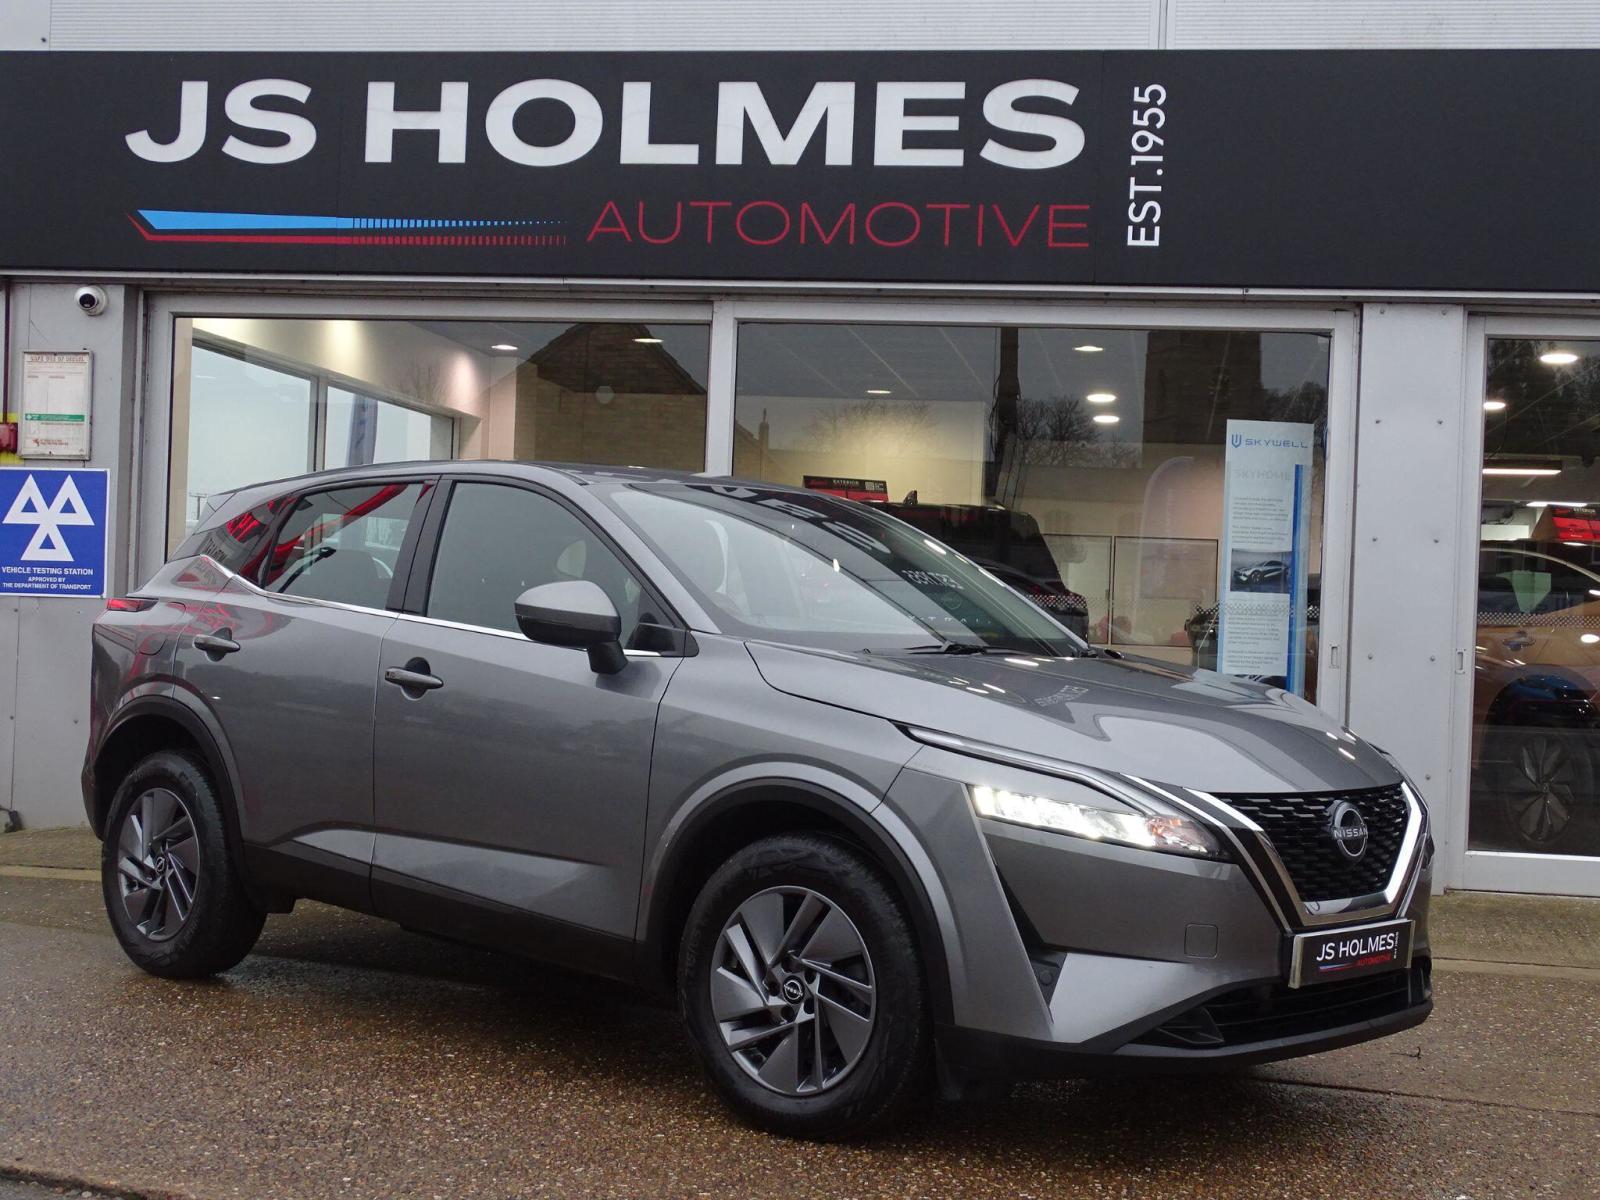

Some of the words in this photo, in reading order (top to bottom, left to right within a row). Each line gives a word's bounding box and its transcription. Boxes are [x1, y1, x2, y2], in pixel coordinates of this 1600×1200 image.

[125, 78, 317, 165] JS
[364, 78, 1086, 170] HOLMES
[1126, 83, 1167, 248] EST.1955
[587, 200, 1091, 249] AUTOMOTIVE
[1244, 437, 1309, 449] SKYWELL
[2, 566, 31, 574] VEHICLE
[32, 567, 63, 575] TESTING
[63, 567, 94, 576] STATION
[1333, 827, 1369, 838] NISSAN
[1316, 942, 1336, 962] JS
[1338, 932, 1395, 958] HOLMES
